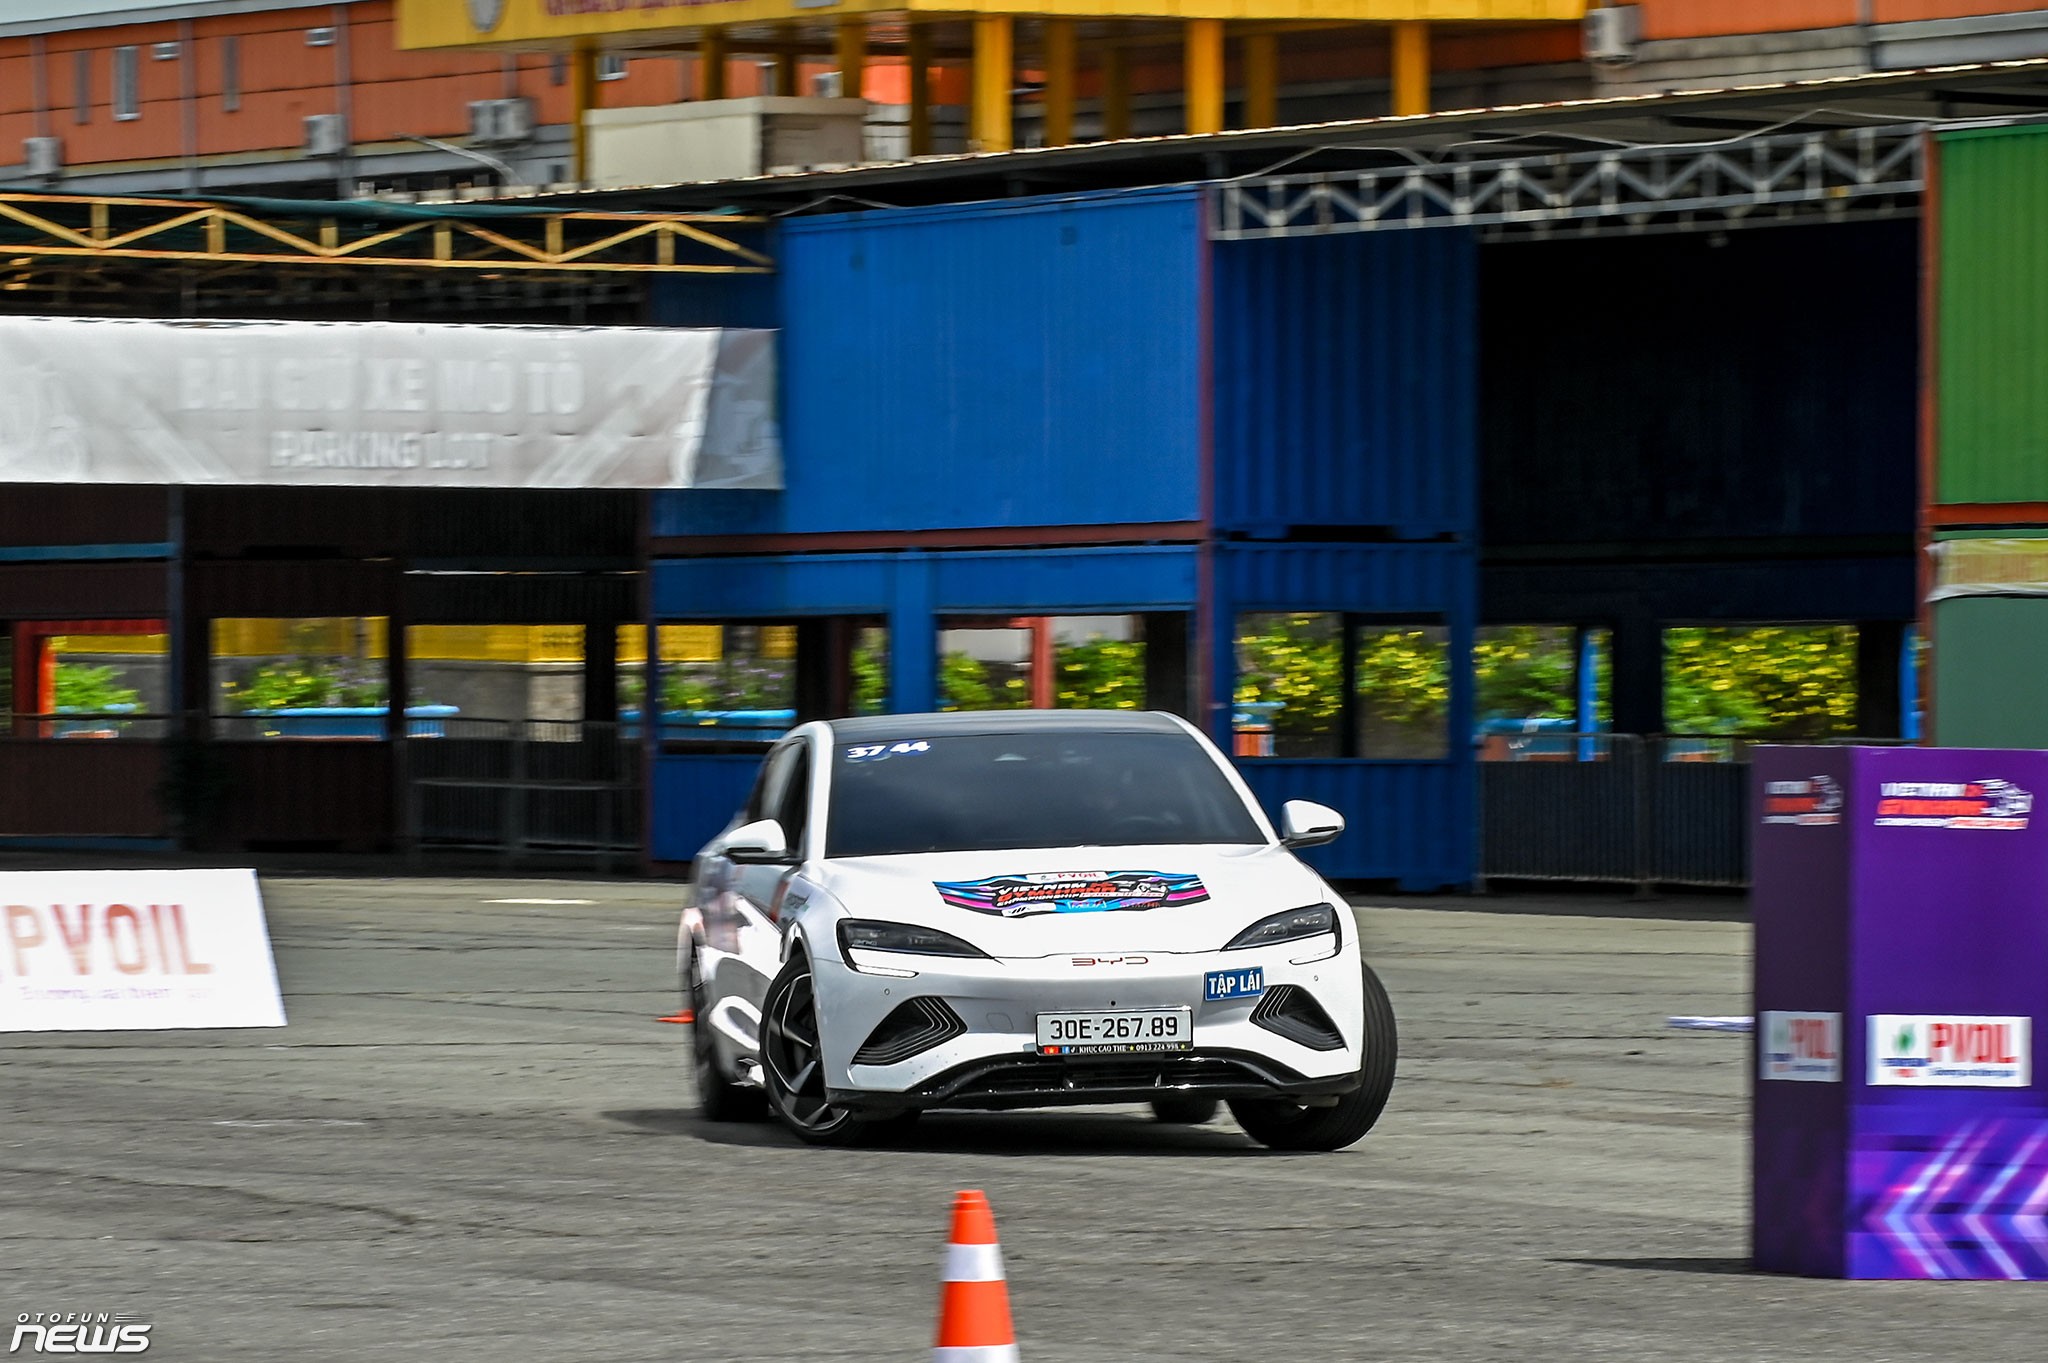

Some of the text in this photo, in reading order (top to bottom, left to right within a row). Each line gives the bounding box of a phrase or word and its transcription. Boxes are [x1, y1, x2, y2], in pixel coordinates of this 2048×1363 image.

[360, 358, 428, 413] XE
[269, 430, 495, 470] PARKING LOT
[847, 741, 931, 758] 37 44
[996, 893, 1080, 906] CHAMPIONSHIP
[998, 882, 1087, 895] VIETNAM
[2, 903, 214, 976] PVOIL
[1071, 957, 1149, 967] BYD
[1208, 970, 1261, 998] TẬP LÁI
[1049, 1016, 1178, 1039] 30E-267.89
[1927, 1022, 2017, 1063] PVOIL
